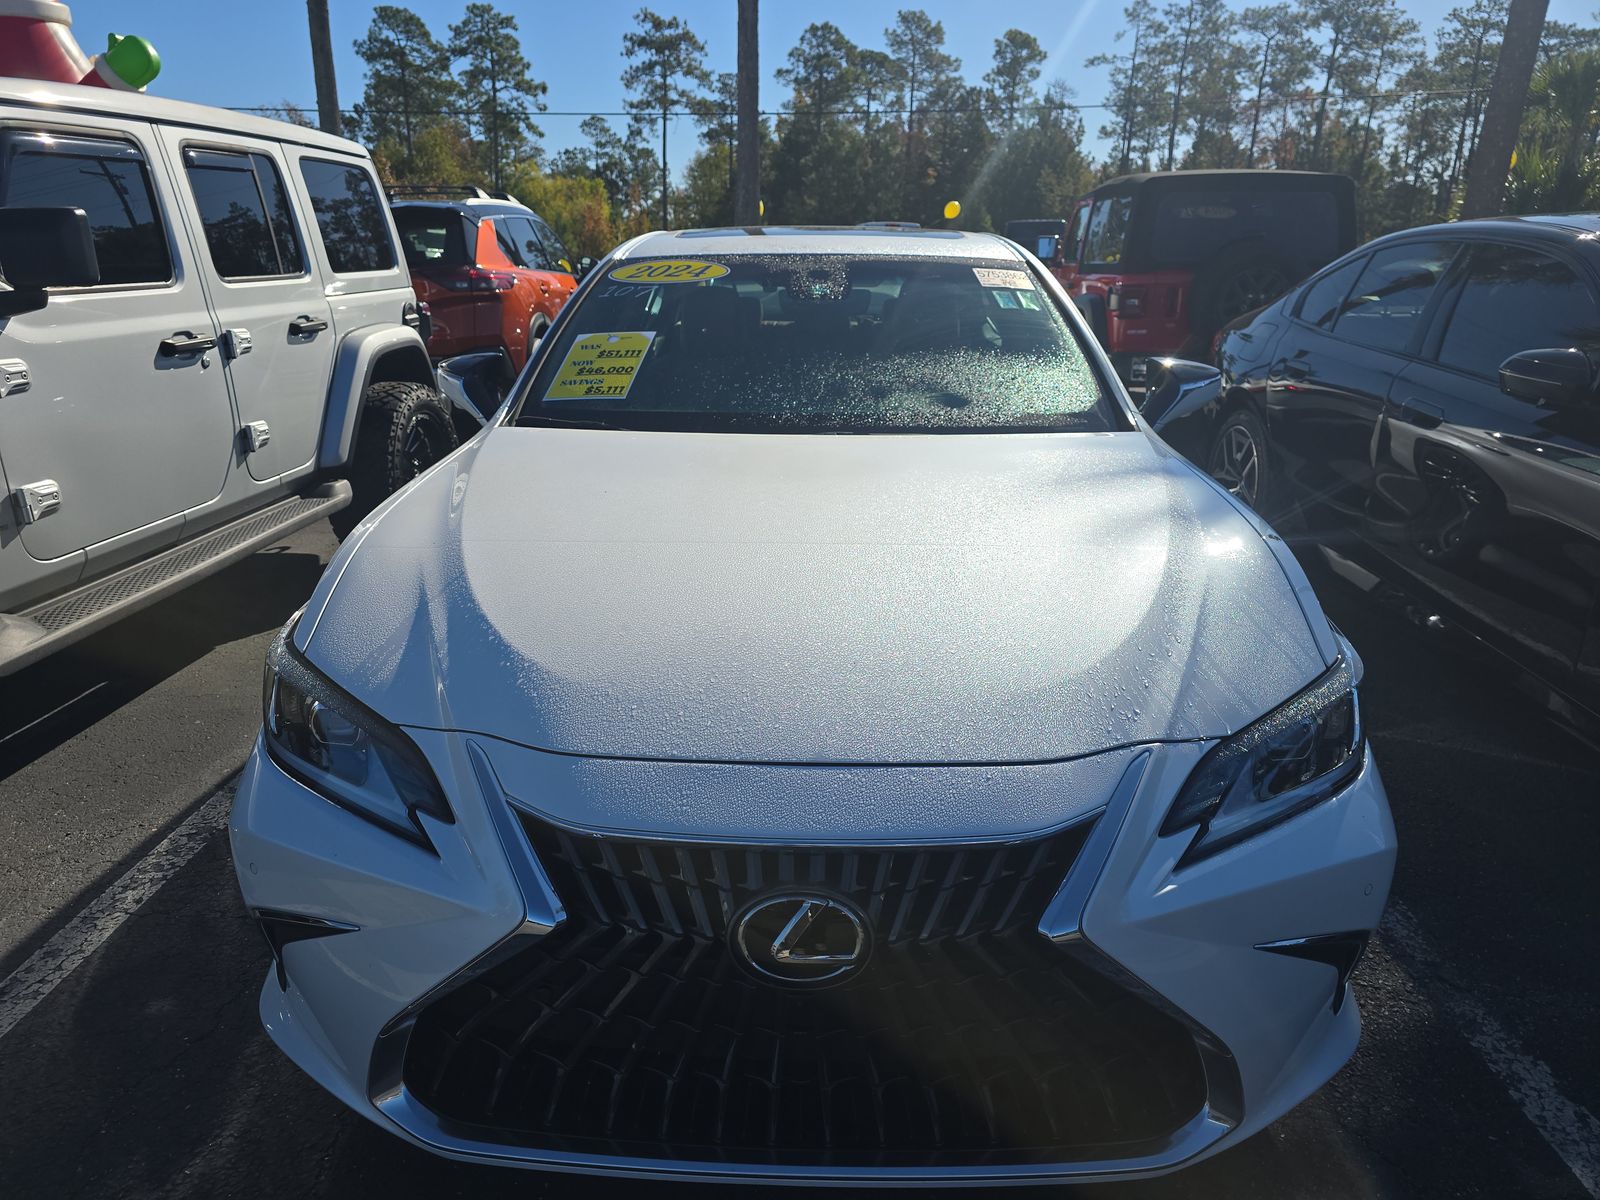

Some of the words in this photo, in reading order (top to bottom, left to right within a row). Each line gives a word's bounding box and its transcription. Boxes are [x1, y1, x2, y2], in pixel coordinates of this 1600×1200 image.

[626, 264, 713, 279] 2024
[596, 349, 643, 358] $51,111
[570, 359, 596, 367] NOW
[576, 366, 635, 376] $46,000
[560, 378, 605, 386] SAVINGS
[584, 385, 626, 395] $5,111
